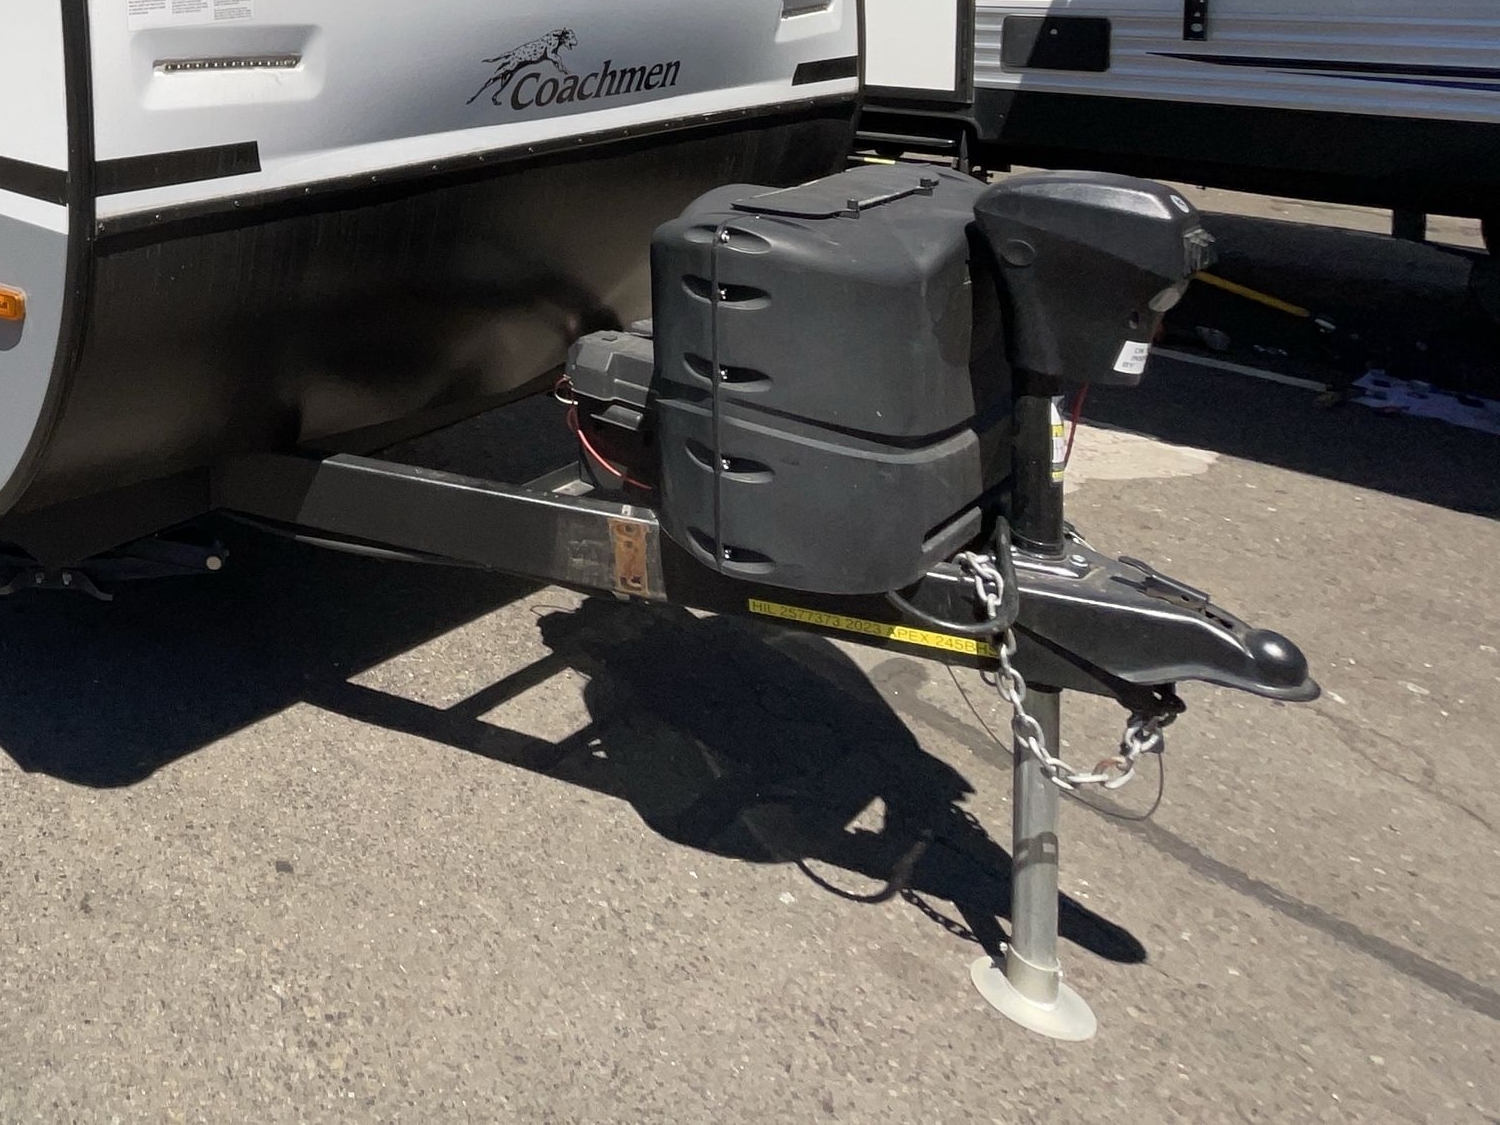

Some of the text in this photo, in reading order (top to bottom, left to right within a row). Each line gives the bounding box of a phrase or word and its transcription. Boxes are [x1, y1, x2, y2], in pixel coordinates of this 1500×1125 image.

[510, 59, 681, 110] Coachmen
[846, 618, 881, 634] 2023
[887, 626, 930, 643] APEX
